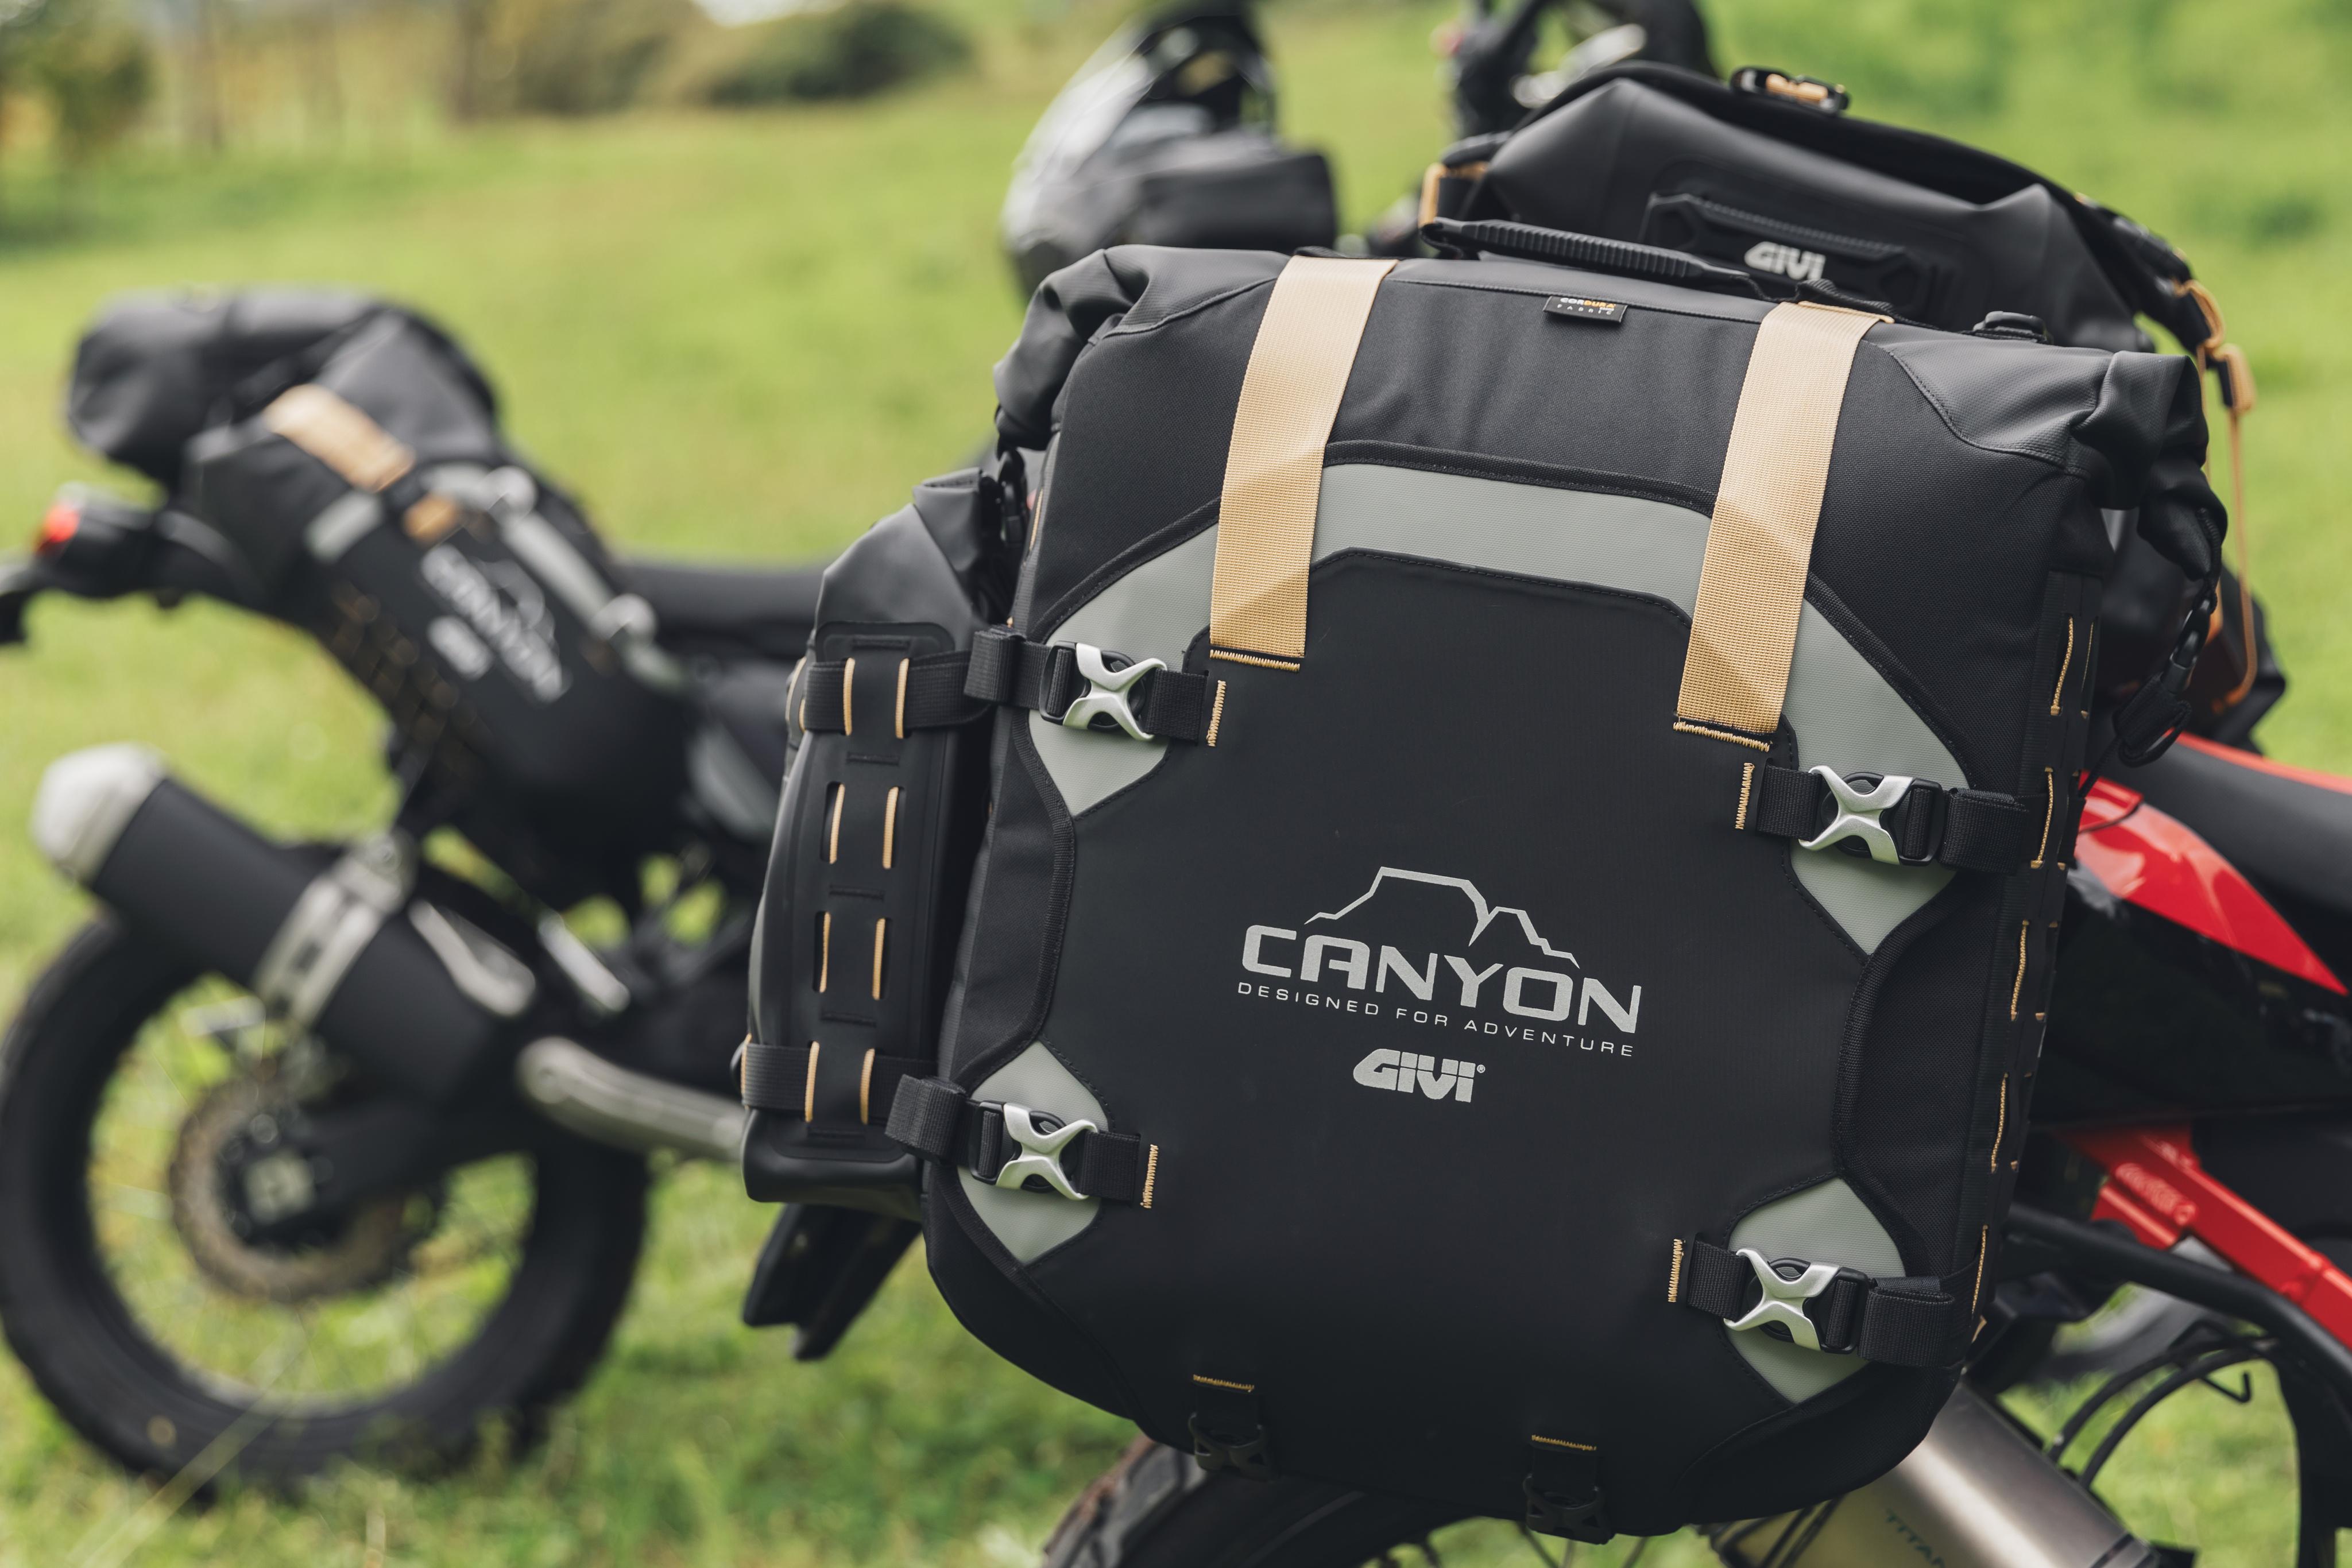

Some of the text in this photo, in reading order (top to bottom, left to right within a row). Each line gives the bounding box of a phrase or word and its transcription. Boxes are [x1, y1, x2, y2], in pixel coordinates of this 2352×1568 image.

[1744, 241, 1826, 281] GIVI
[1557, 304, 1612, 315] FABRIC
[1560, 297, 1616, 308] CORDURA
[1241, 924, 1642, 1034] CANYON
[1237, 982, 1634, 1057] DESIGNED FOR ADVENTURE
